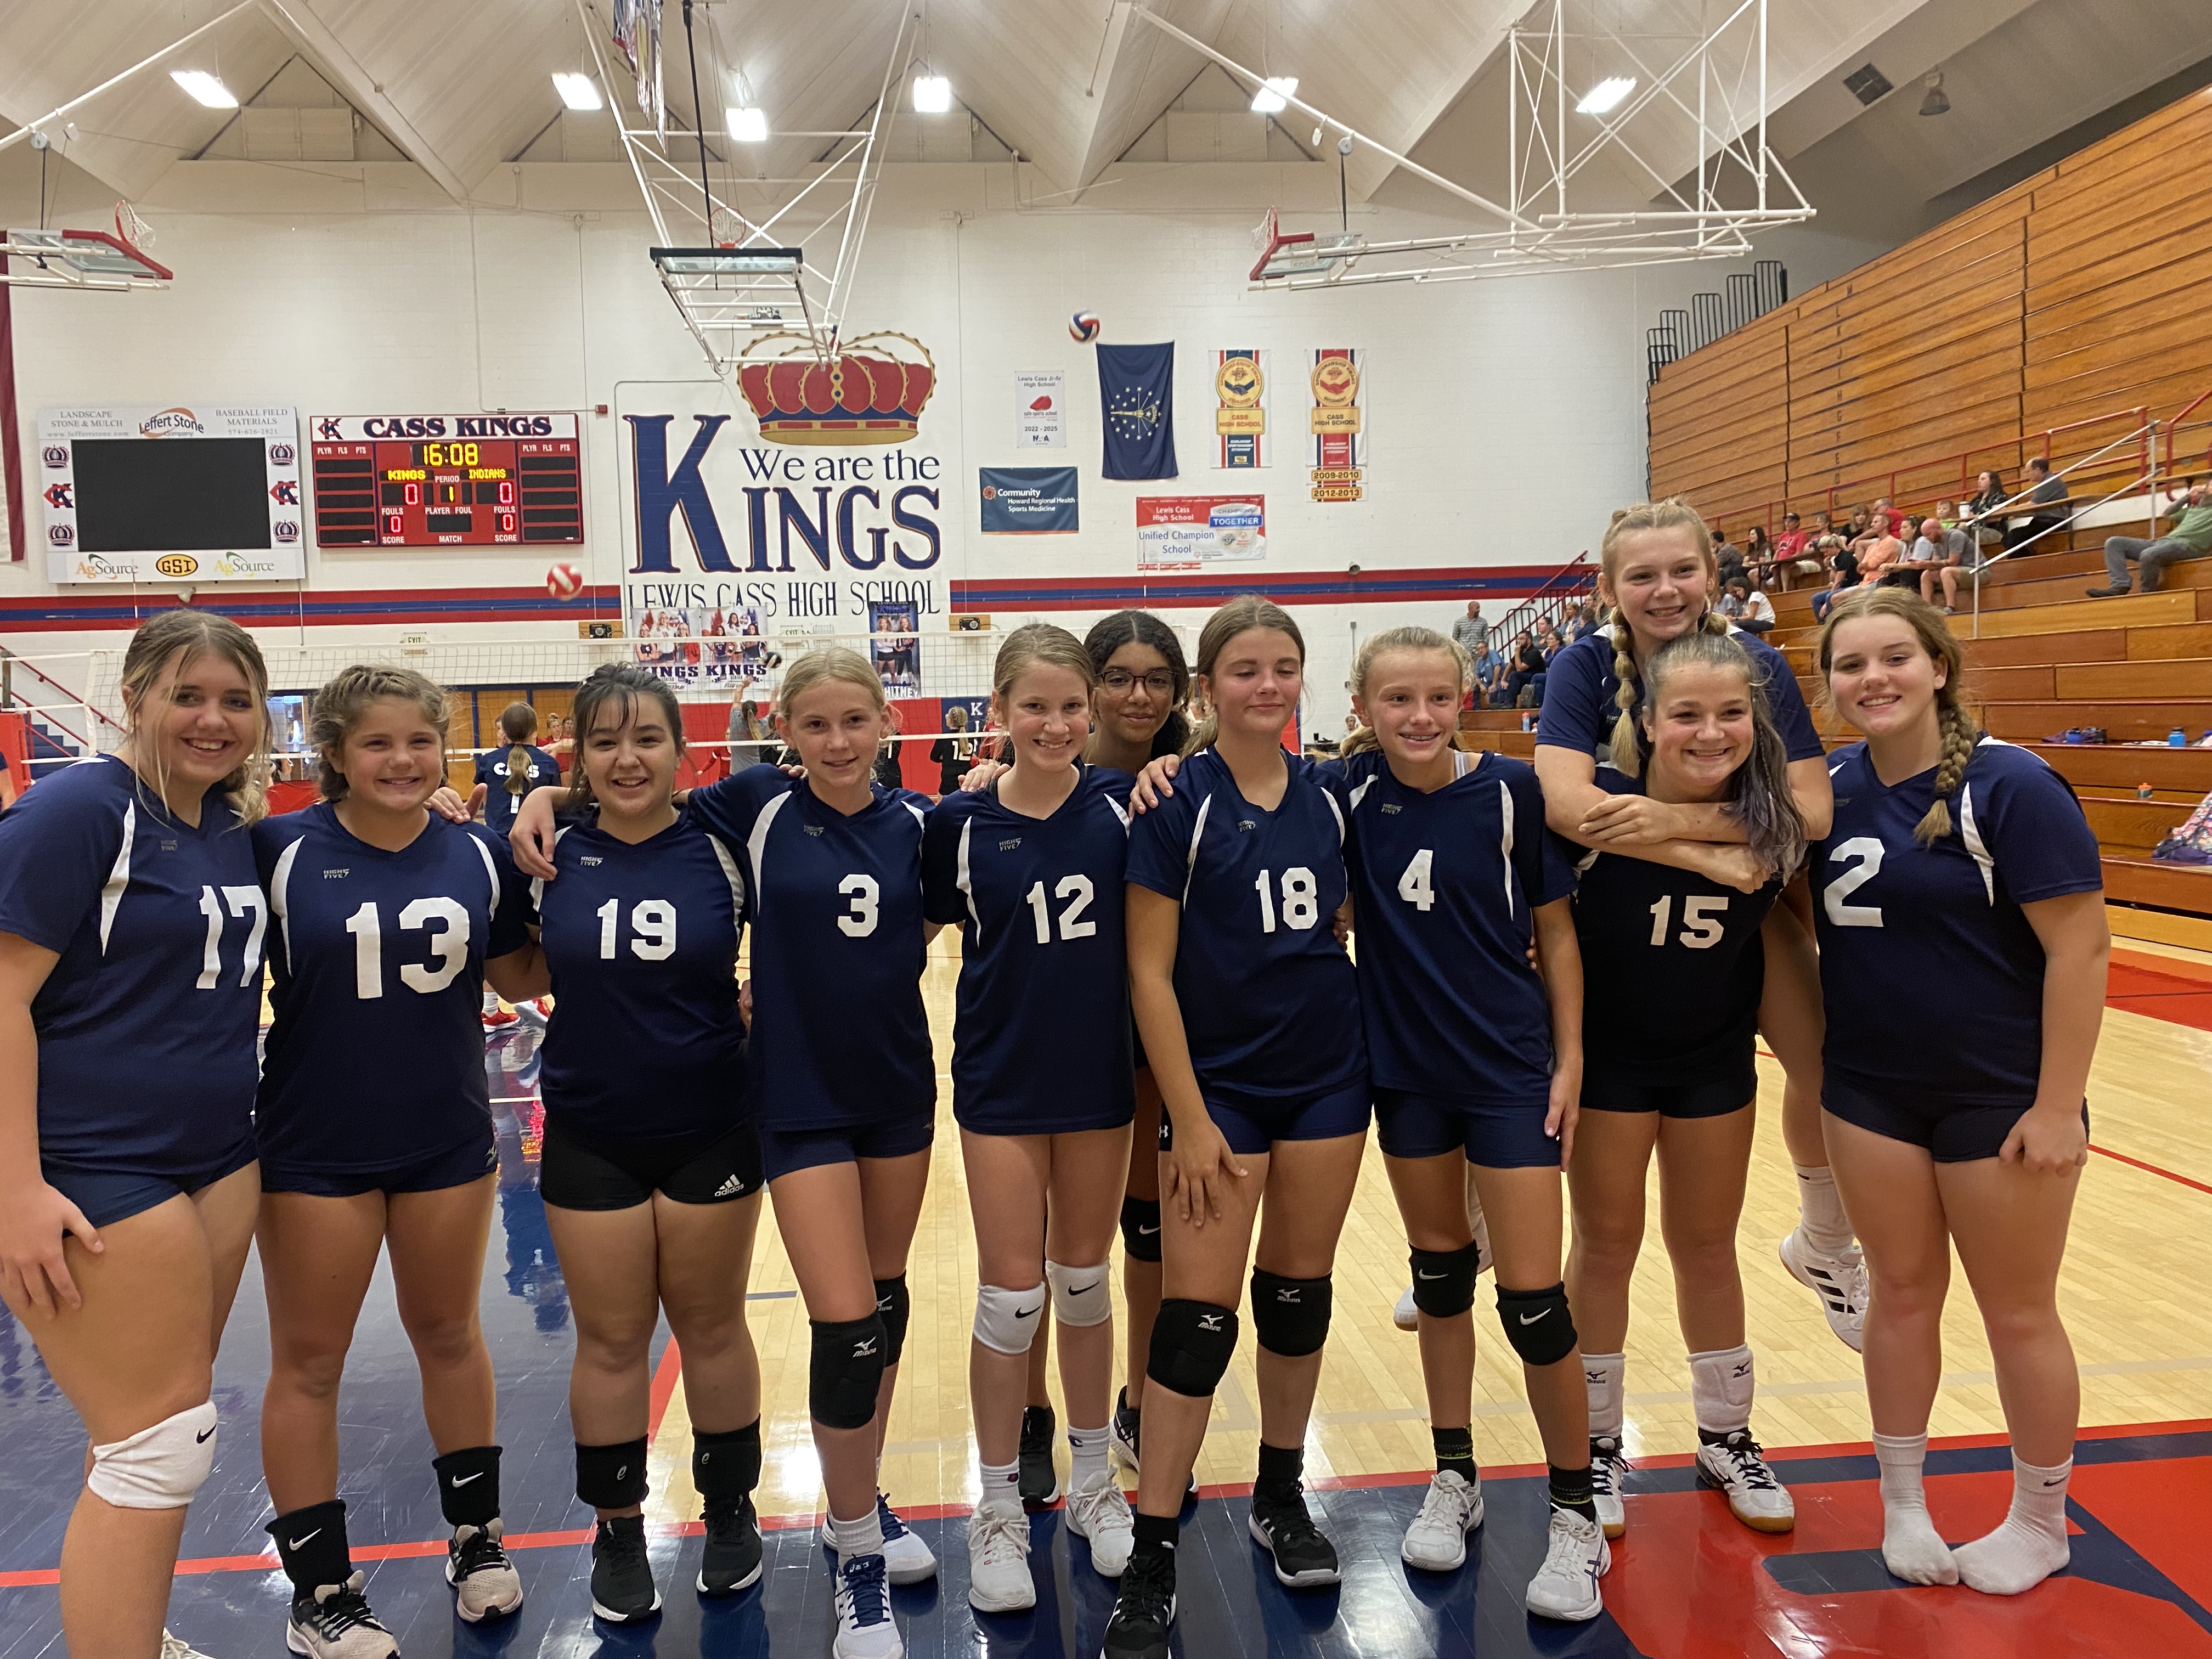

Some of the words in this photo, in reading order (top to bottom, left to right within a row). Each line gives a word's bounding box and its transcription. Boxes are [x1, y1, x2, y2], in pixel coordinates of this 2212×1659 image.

[139, 415, 172, 435] Leffert
[174, 414, 204, 433] Stone
[363, 417, 446, 438] CASS
[455, 416, 552, 437] KINGS
[424, 443, 478, 466] 16:08
[739, 448, 805, 481] We
[814, 456, 873, 481] are
[882, 448, 940, 481] the
[1835, 453, 1839, 464] E
[387, 470, 426, 481] KINGS
[469, 469, 506, 479] INDIANS
[405, 483, 418, 505] 0
[499, 482, 512, 504] 0
[622, 414, 941, 573] KINGS
[997, 488, 1041, 498] Community
[391, 516, 401, 533] 0
[503, 514, 514, 531] 0
[1139, 531, 1169, 540] Unified
[1172, 531, 1214, 541] Champion
[1163, 545, 1191, 553] School
[76, 561, 138, 579] AgSource
[162, 559, 193, 572] GSI
[213, 558, 274, 577] AgSource
[787, 581, 838, 617] HIGH
[705, 664, 766, 676] KINGS
[882, 686, 918, 698] HITNEY
[494, 762, 540, 778] CS
[1397, 849, 1435, 911] 4
[1824, 837, 1886, 927] 2
[837, 874, 879, 937] 3
[1026, 874, 1096, 944] 12
[1255, 867, 1318, 933] 18
[597, 899, 676, 961] 19
[1650, 895, 1729, 949] 15
[196, 885, 267, 989] 17
[346, 896, 470, 999] 13
[714, 1183, 744, 1197] adidas
